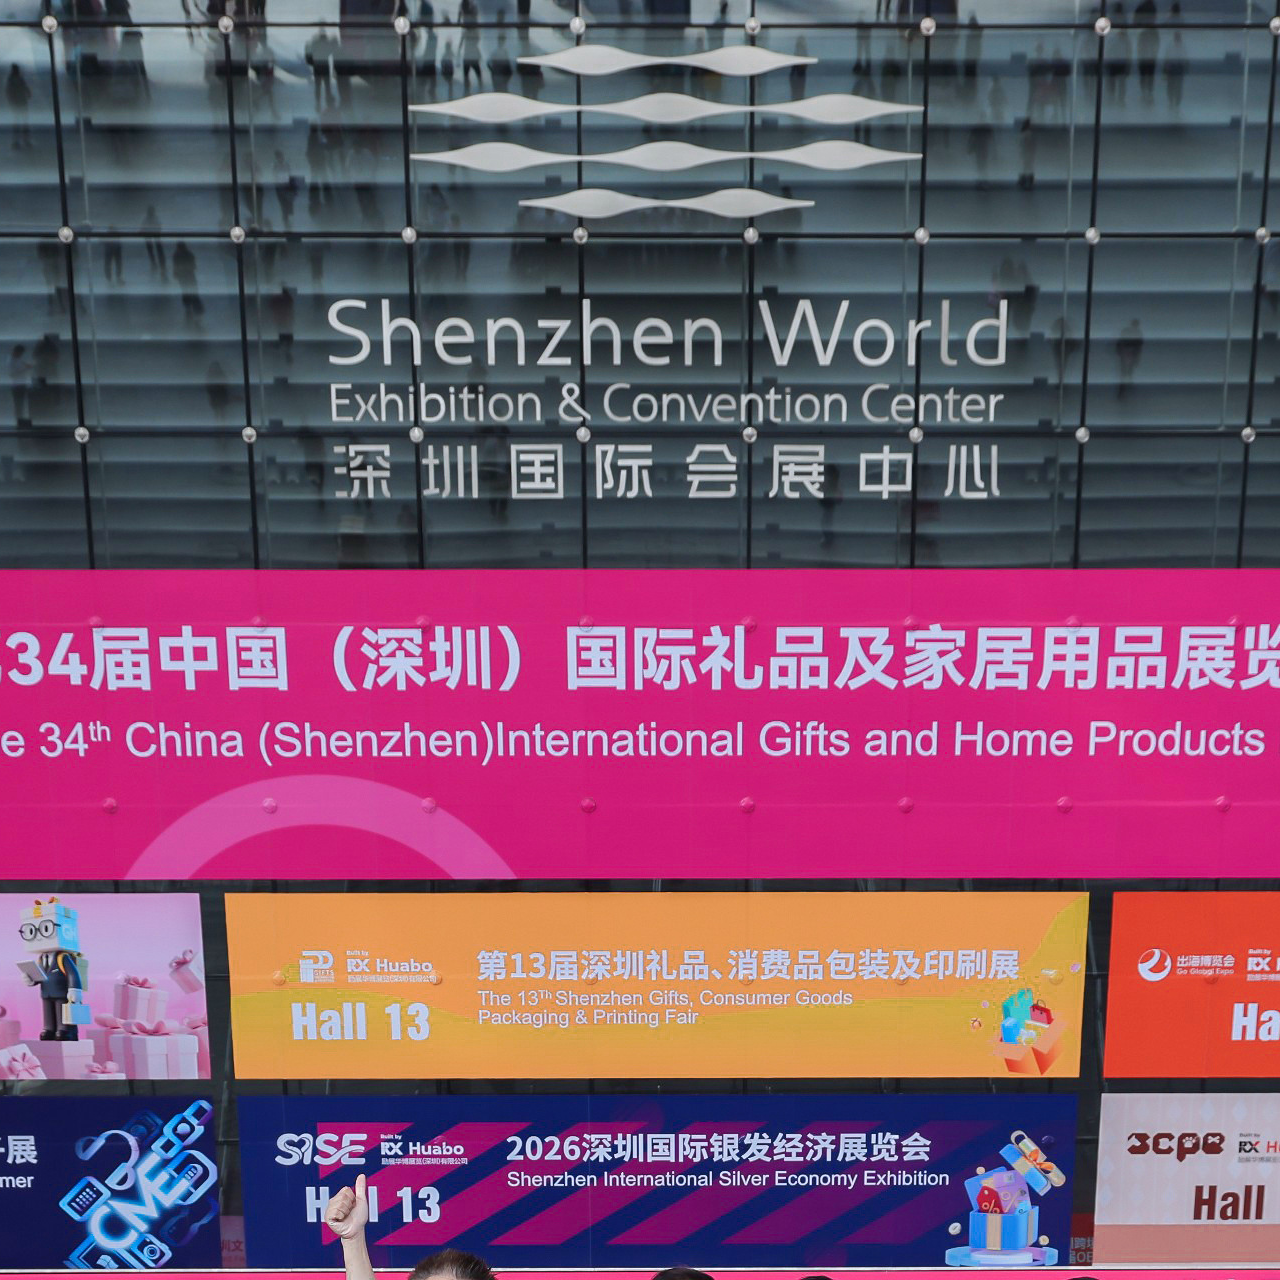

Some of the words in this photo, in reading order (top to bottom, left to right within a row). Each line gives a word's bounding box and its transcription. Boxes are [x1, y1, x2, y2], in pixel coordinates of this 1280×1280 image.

[327, 299, 722, 366] Shenzhen
[758, 299, 1008, 366] World
[330, 383, 542, 423] Exhibition
[558, 383, 591, 423] &
[603, 383, 847, 423] Convention
[862, 383, 1003, 423] Center
[334, 444, 1000, 499] 深圳国际会展中心
[40, 721, 111, 757] 34th
[125, 721, 244, 757] China
[759, 720, 850, 757] Gifts
[864, 721, 938, 757] and
[954, 721, 1073, 757] Home
[1089, 721, 1264, 757] Products
[347, 959, 370, 972] RX
[376, 959, 433, 972] Huabo
[477, 949, 1019, 981] 第13届深圳礼品、消费品包装及印刷展
[1176, 955, 1235, 967] 出海博览会
[1176, 968, 1188, 976] Go
[1216, 968, 1235, 977] Expo
[1247, 957, 1271, 971] RX
[478, 990, 511, 1006] The
[556, 990, 643, 1006] Shenzhen
[649, 990, 693, 1008] Gifts,
[700, 990, 791, 1006] Consumer
[796, 990, 852, 1006] Goods
[291, 1002, 367, 1041] Hall
[385, 1002, 430, 1041] 13
[478, 1009, 570, 1028] Packaging
[576, 1010, 588, 1025] &
[593, 1009, 659, 1028] Printing
[665, 1010, 698, 1025] Fair
[380, 1142, 403, 1155] RX
[409, 1142, 465, 1155] Huabo
[506, 1132, 931, 1163] 2026深圳国际银发经济展览会
[1238, 1140, 1260, 1154] RX
[507, 1171, 597, 1187] Shenzhen
[604, 1171, 713, 1187] International
[719, 1171, 769, 1187] Silver
[774, 1171, 858, 1190] Economy
[863, 1171, 949, 1187] Exhibition
[305, 1186, 378, 1223] Hl
[397, 1186, 440, 1223] 13
[1193, 1185, 1265, 1220] Hall
